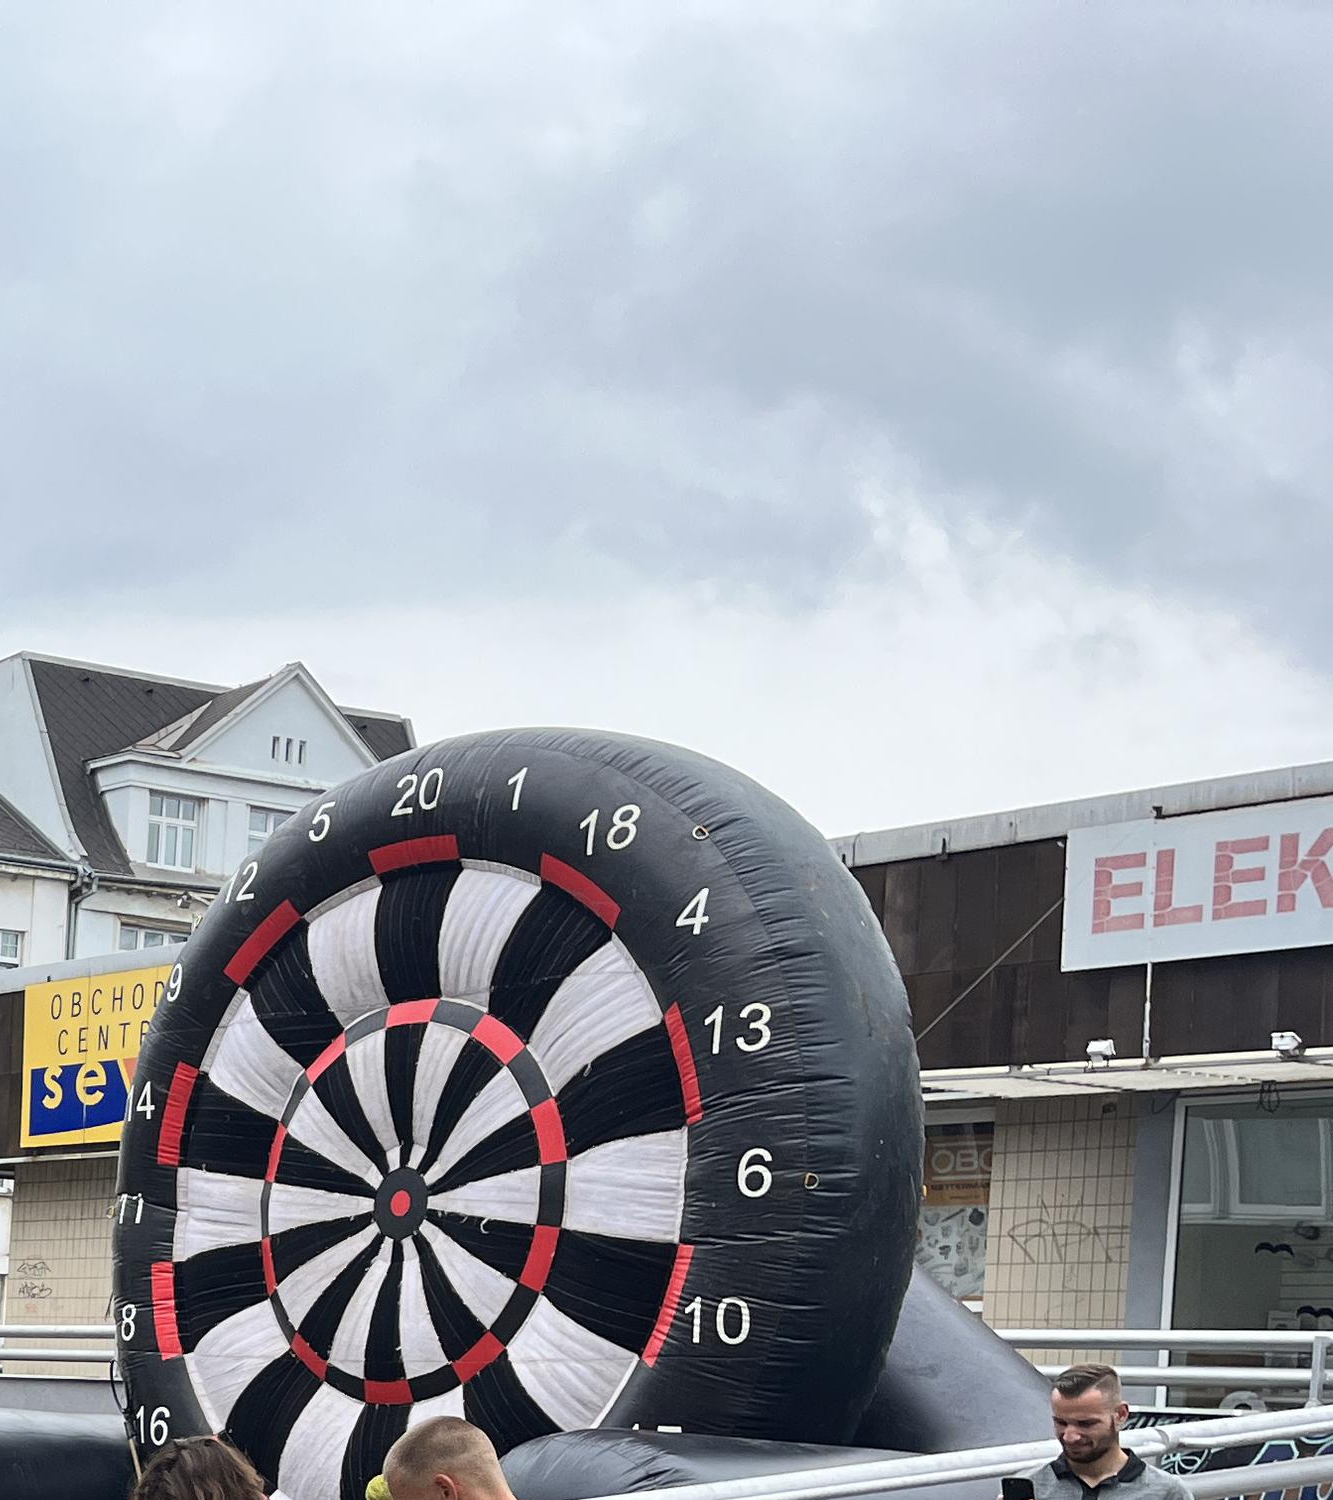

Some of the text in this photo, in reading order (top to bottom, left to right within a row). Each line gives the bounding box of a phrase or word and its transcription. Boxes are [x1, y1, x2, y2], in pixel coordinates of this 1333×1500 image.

[391, 767, 445, 818] 20
[507, 767, 529, 811] 1
[308, 802, 336, 841] 5
[579, 804, 641, 856] 18
[224, 861, 256, 905] 12
[1091, 827, 1333, 935] ELEK
[675, 887, 710, 935] 4
[166, 963, 183, 1002] 9
[703, 1002, 772, 1055] 13
[126, 1081, 155, 1121] 14
[737, 1147, 774, 1198] 6
[120, 1304, 135, 1342] 8
[684, 1296, 750, 1345] 10
[135, 1406, 169, 1446] 16
